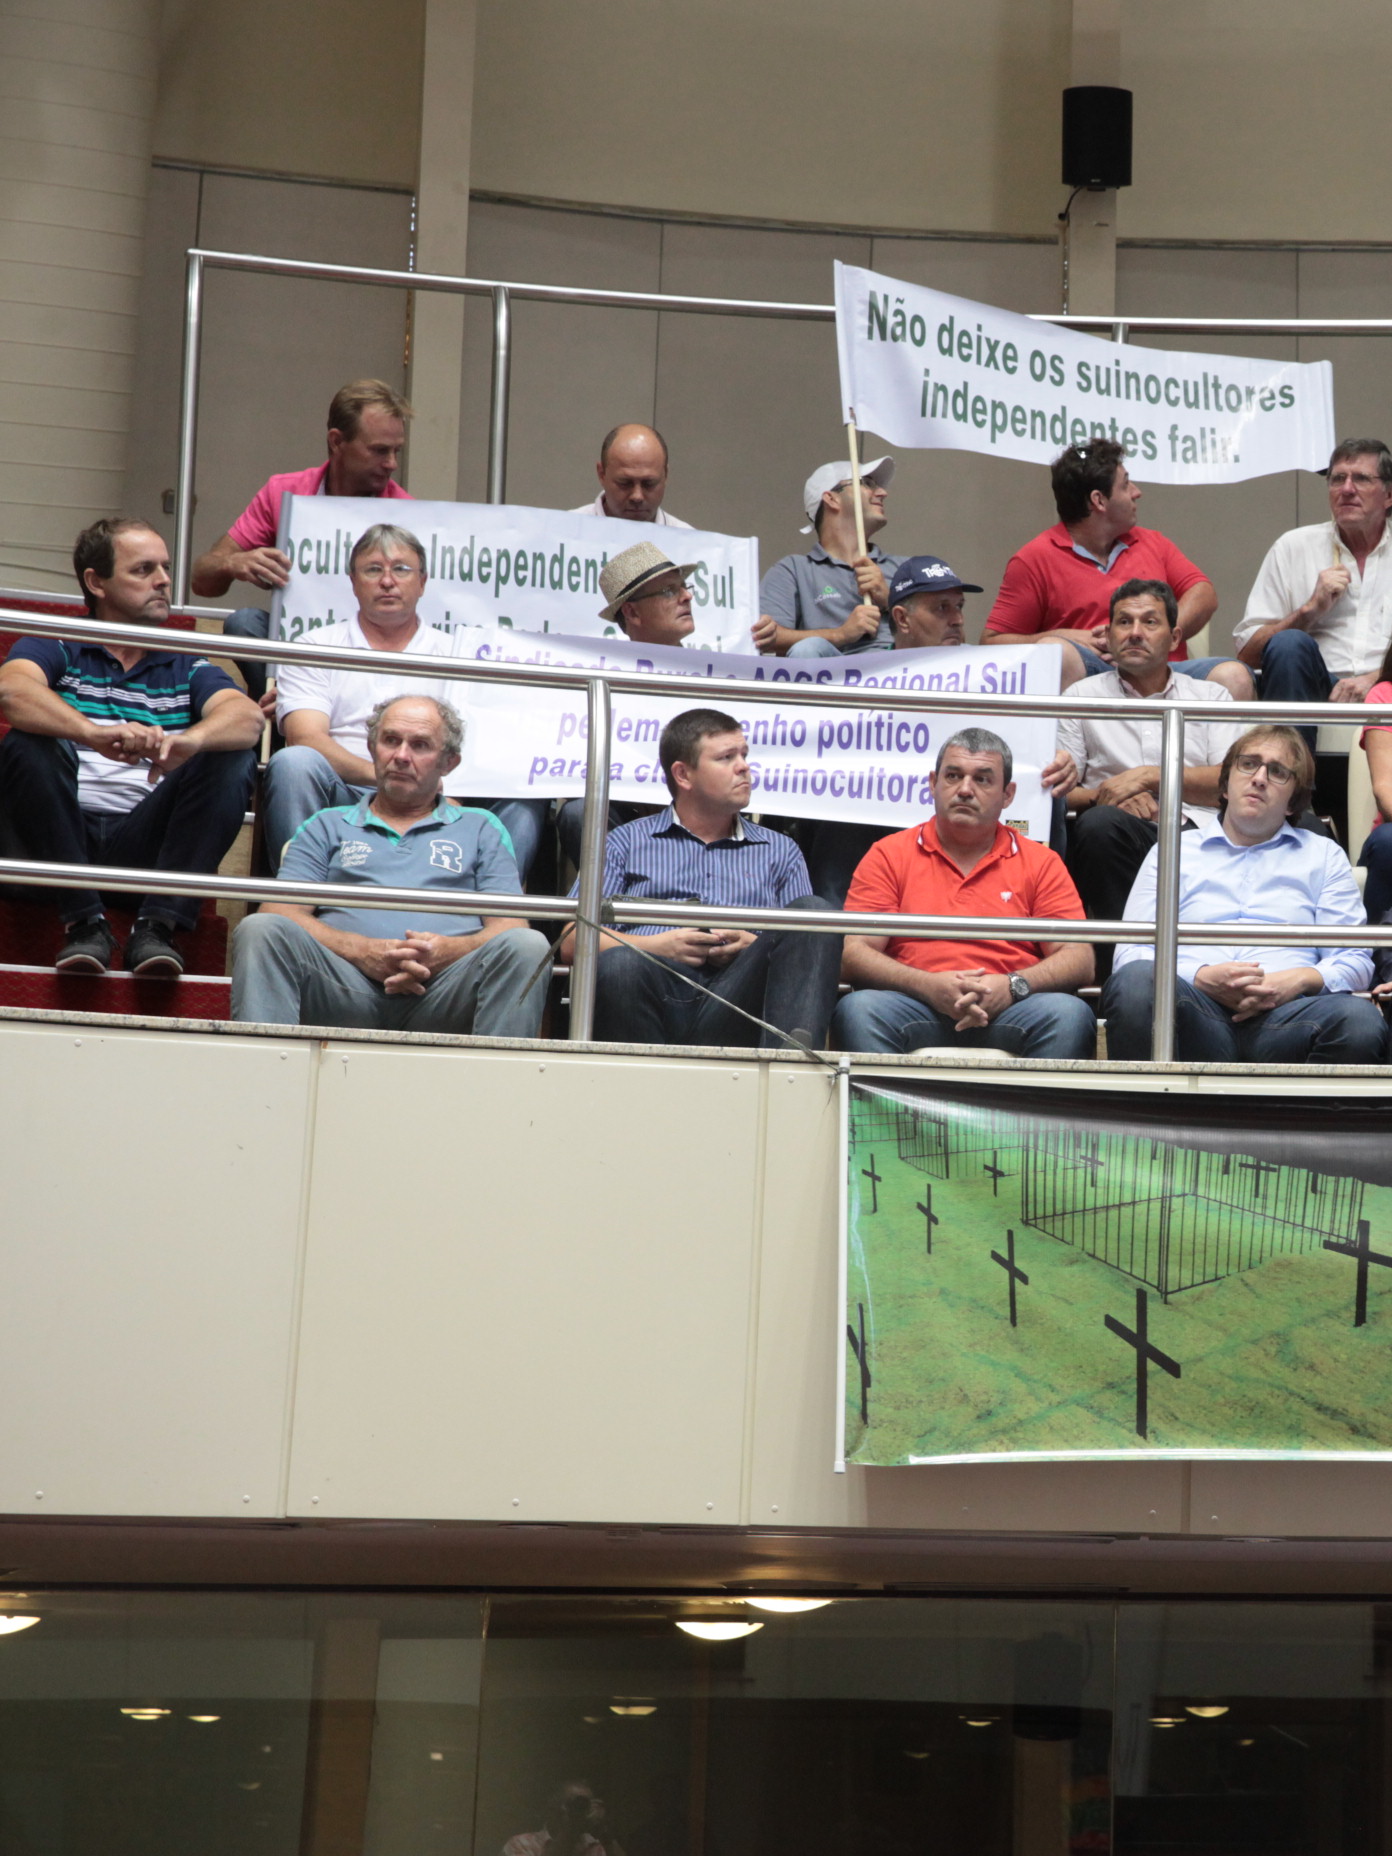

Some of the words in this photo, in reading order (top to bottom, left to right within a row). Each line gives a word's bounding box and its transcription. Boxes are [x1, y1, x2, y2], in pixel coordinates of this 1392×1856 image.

[867, 288, 926, 346] Não
[937, 314, 1019, 375] deixe
[1029, 348, 1065, 387] os
[1076, 359, 1296, 413] suinocultores
[1168, 423, 1240, 464] falir.
[693, 560, 734, 609] Sul
[980, 662, 1026, 695] Sul
[557, 709, 661, 745] peem
[817, 710, 930, 758] político
